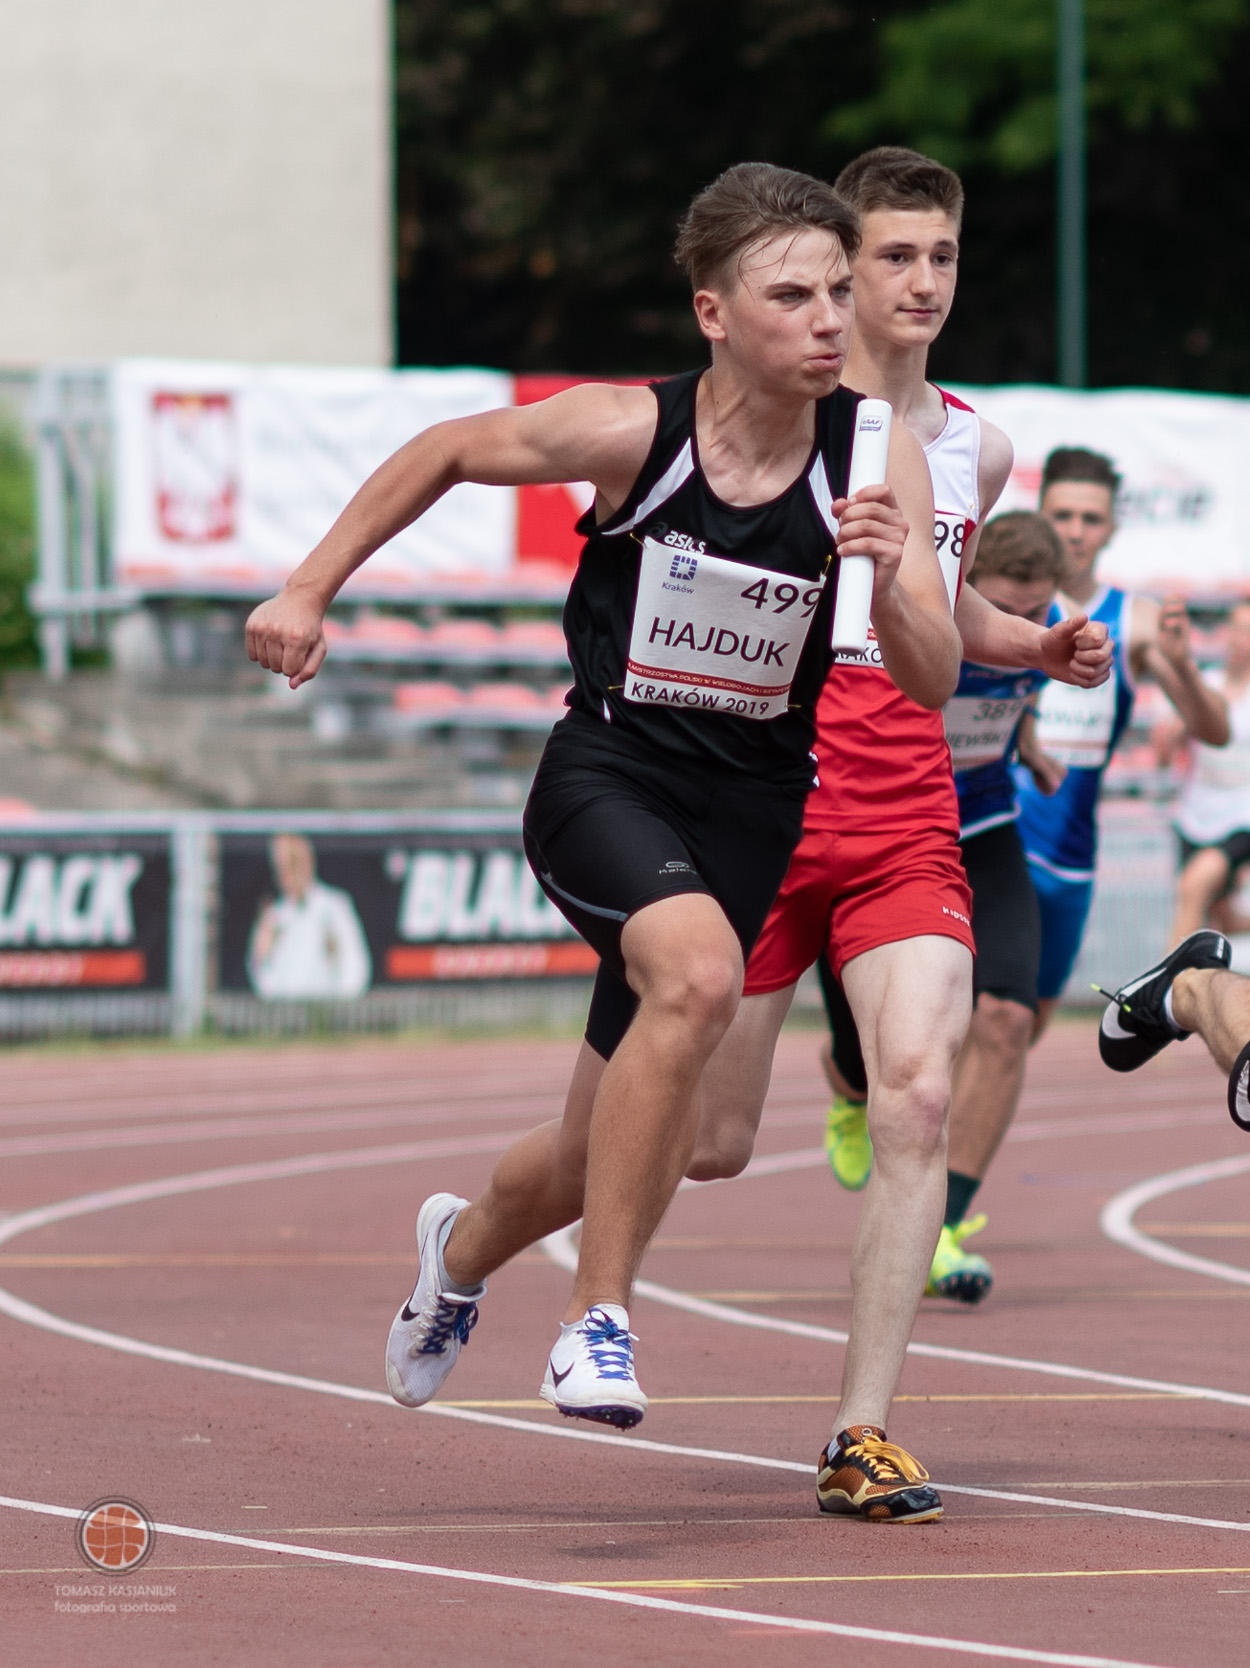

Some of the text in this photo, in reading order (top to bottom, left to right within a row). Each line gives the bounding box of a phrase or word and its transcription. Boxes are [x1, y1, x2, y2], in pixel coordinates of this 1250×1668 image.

[664, 530, 706, 554] asics
[662, 581, 694, 594] Kraków
[740, 577, 823, 618] 499
[648, 616, 790, 667] HAJDUK
[631, 681, 770, 715] KRAKÓW 2019
